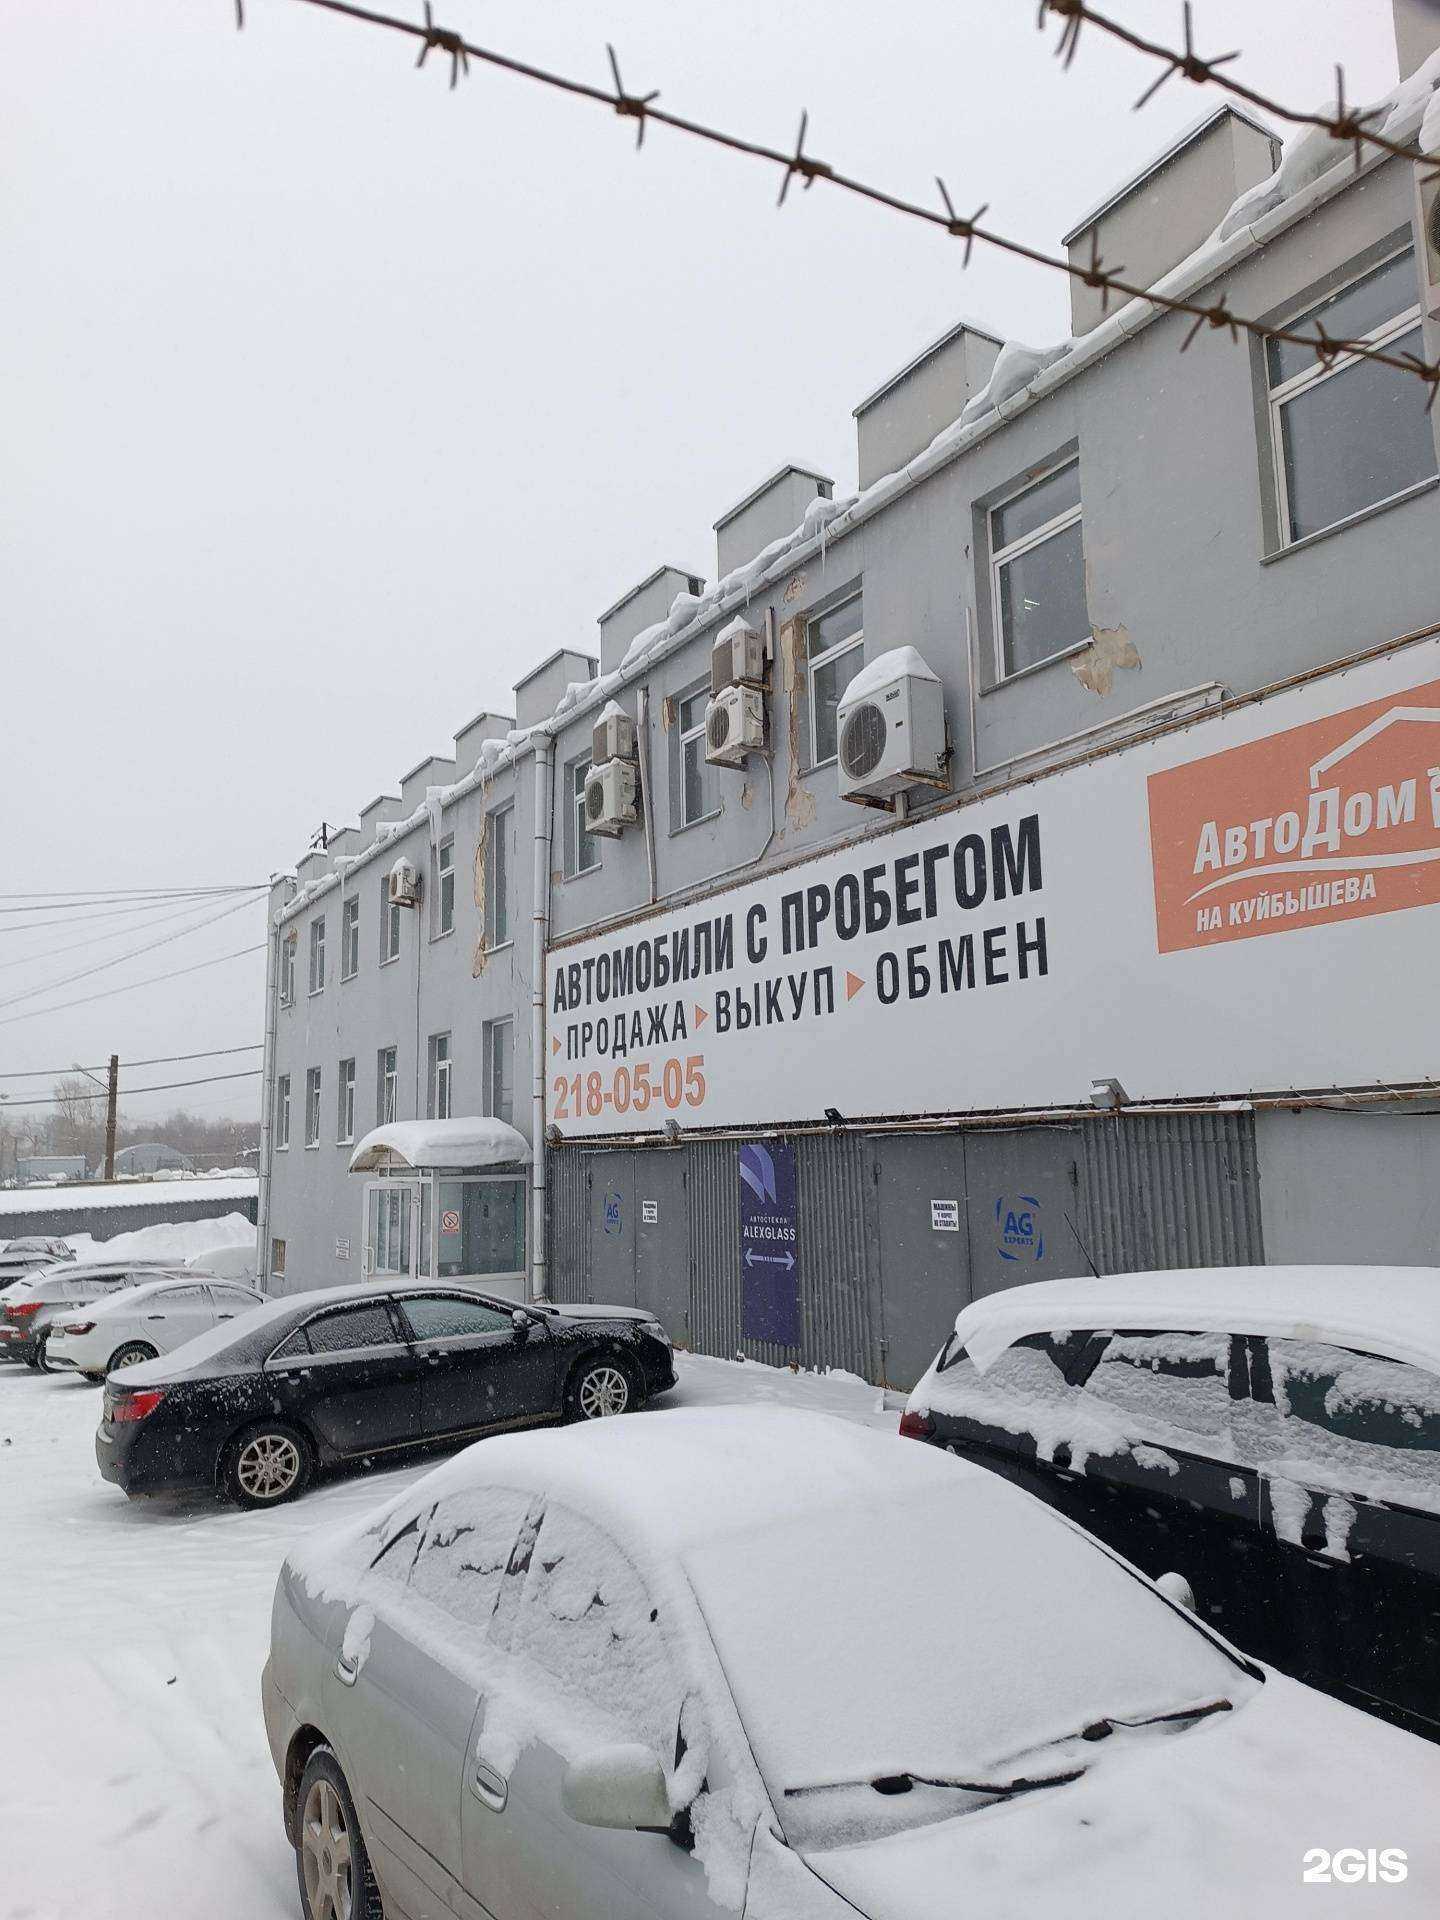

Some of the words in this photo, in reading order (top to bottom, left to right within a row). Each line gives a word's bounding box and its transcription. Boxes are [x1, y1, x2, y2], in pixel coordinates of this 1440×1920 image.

[552, 912, 735, 1014] АВТОМОБИЛИ
[745, 902, 768, 964] С
[780, 813, 1045, 955] ПРОБЕГОМ
[1196, 908, 1223, 932] НА
[1228, 873, 1377, 926] КУЙБЫШЕВА
[566, 999, 689, 1061] ПРОДАЖА
[714, 965, 835, 1034] ВЫКУП
[875, 916, 1050, 1005] ОБМЕН
[553, 1054, 707, 1120] 218-05-05
[743, 1225, 796, 1242] ALEXGLASS
[1004, 1211, 1034, 1236] AG
